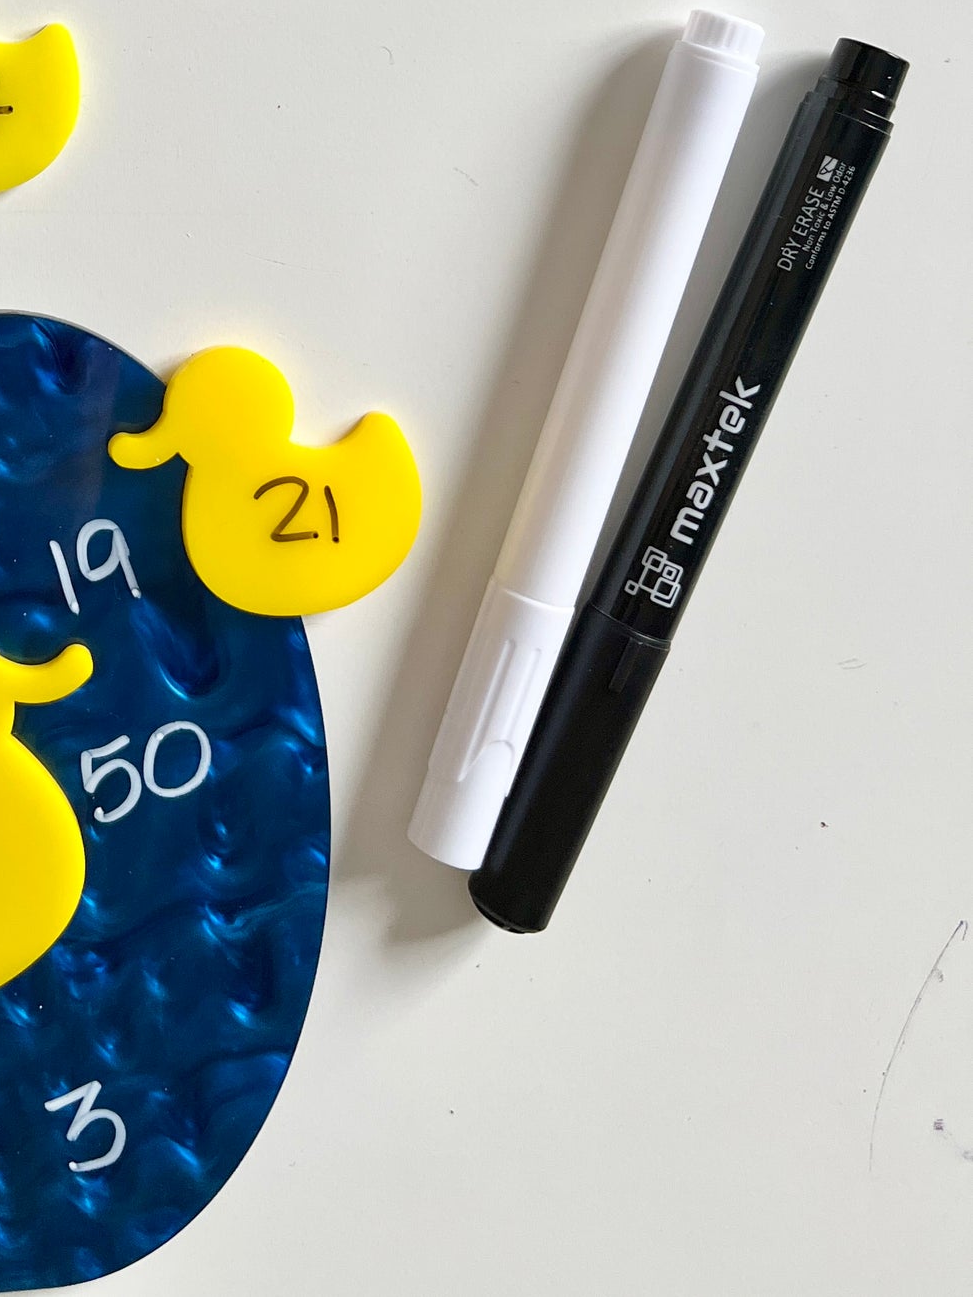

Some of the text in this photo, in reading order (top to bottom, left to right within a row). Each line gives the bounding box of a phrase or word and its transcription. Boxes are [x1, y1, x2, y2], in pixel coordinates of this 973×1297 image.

[777, 186, 825, 272] DRY ERASE
[802, 162, 847, 252] Non Toxic & Low Odor
[805, 231, 827, 270] Conforms
[823, 220, 832, 230] to
[827, 196, 843, 219] ASTM
[670, 374, 761, 547] maxtek
[253, 476, 339, 543] 21
[50, 518, 142, 616] 19
[79, 720, 212, 823] 50
[44, 1081, 127, 1173] 3
